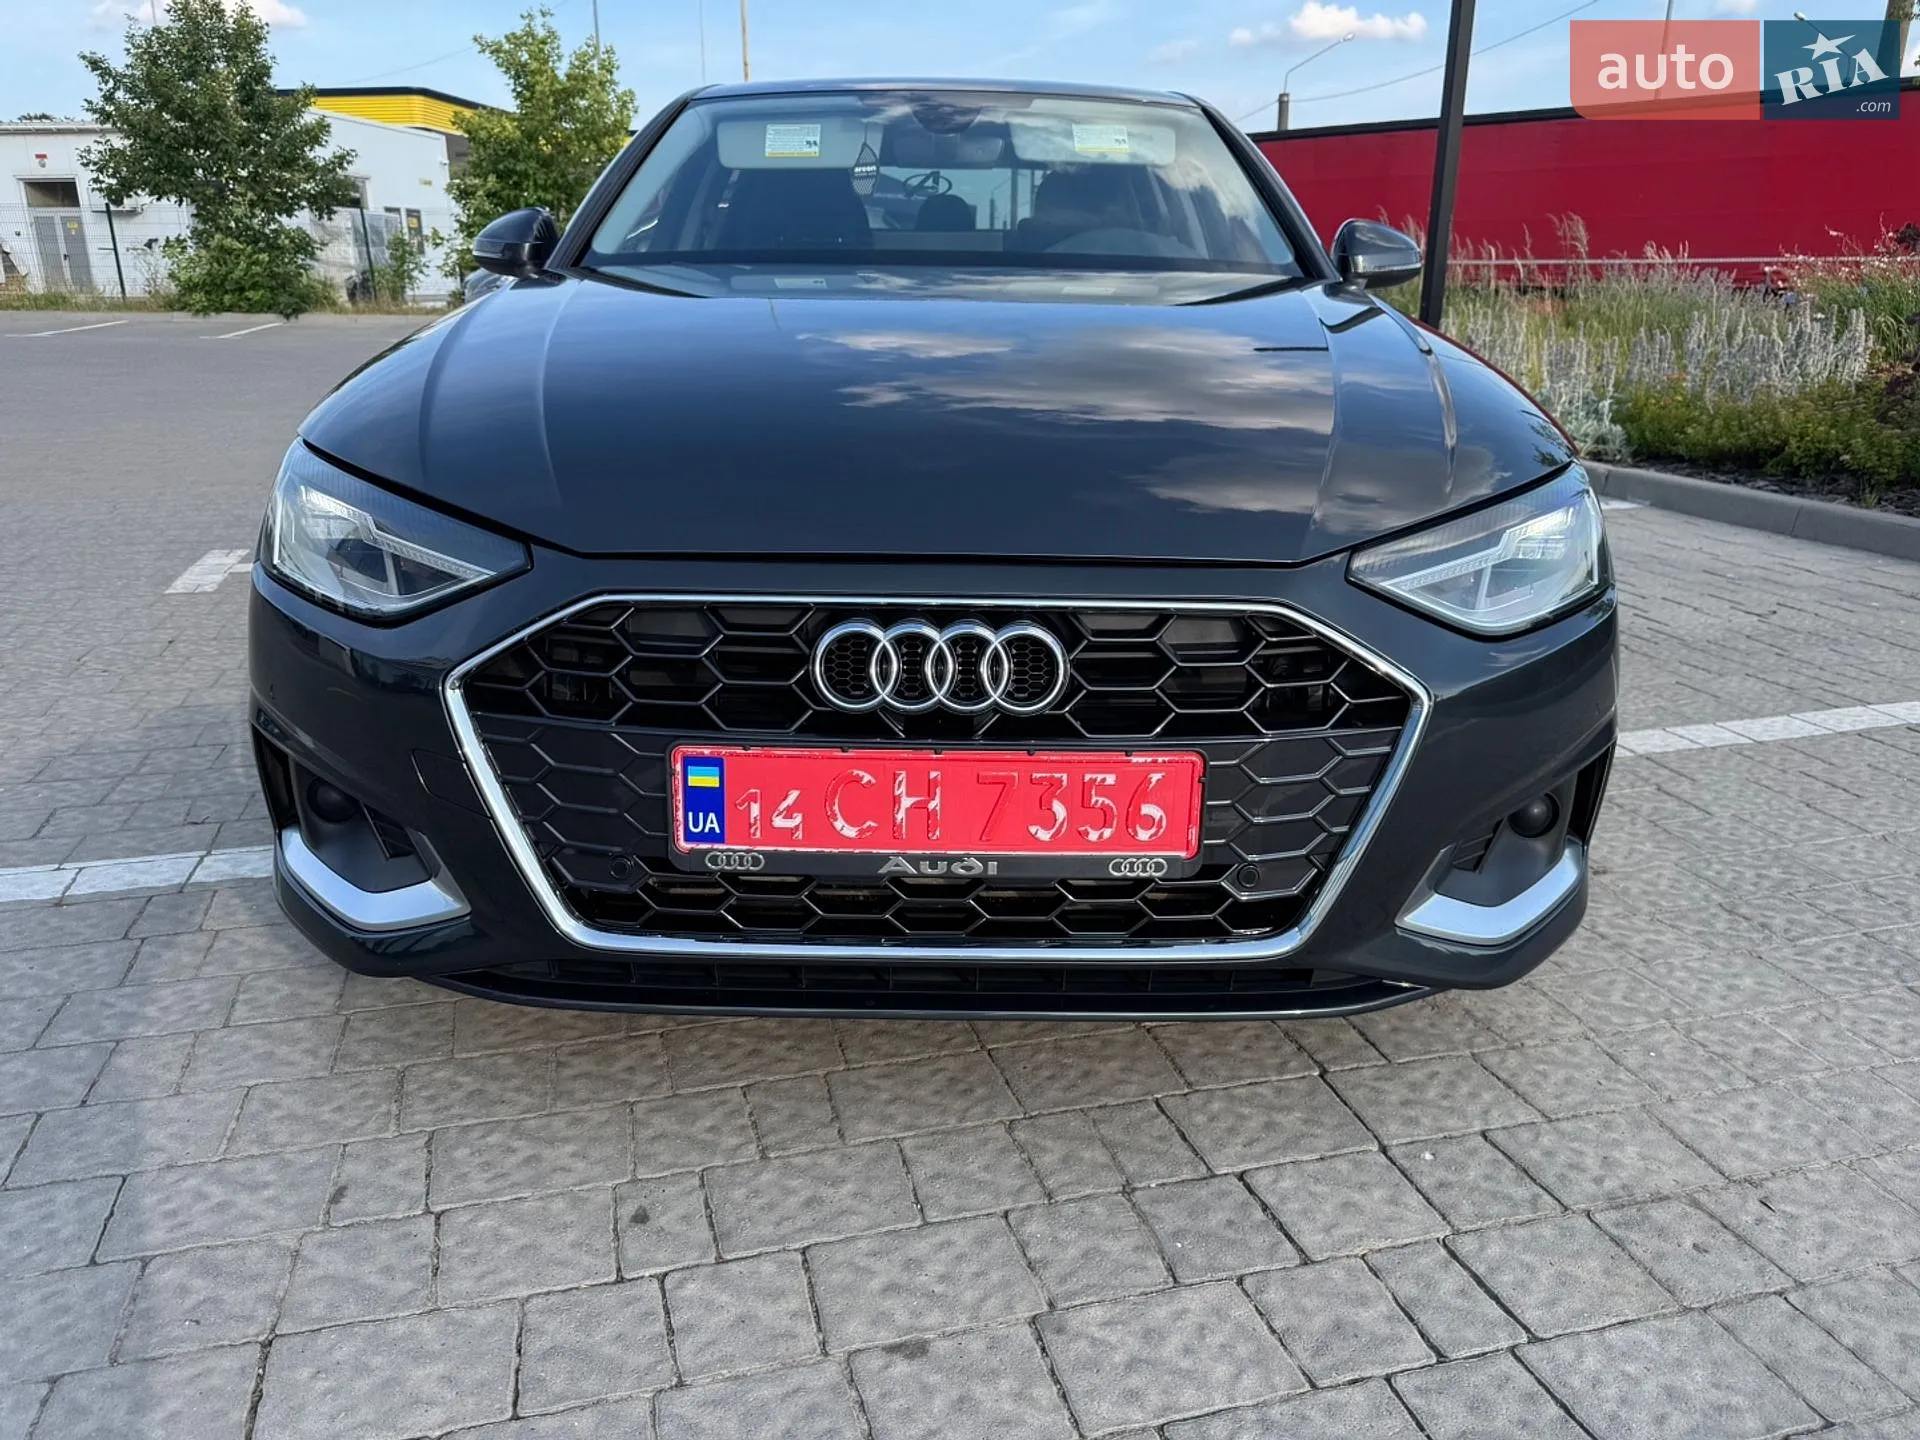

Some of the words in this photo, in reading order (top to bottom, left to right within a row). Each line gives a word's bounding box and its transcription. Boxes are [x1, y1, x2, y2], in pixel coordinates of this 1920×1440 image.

[734, 788, 803, 840] 14
[824, 768, 941, 840] CH
[976, 771, 1167, 842] 7356
[688, 811, 721, 834] UA
[877, 856, 998, 876] Audi
